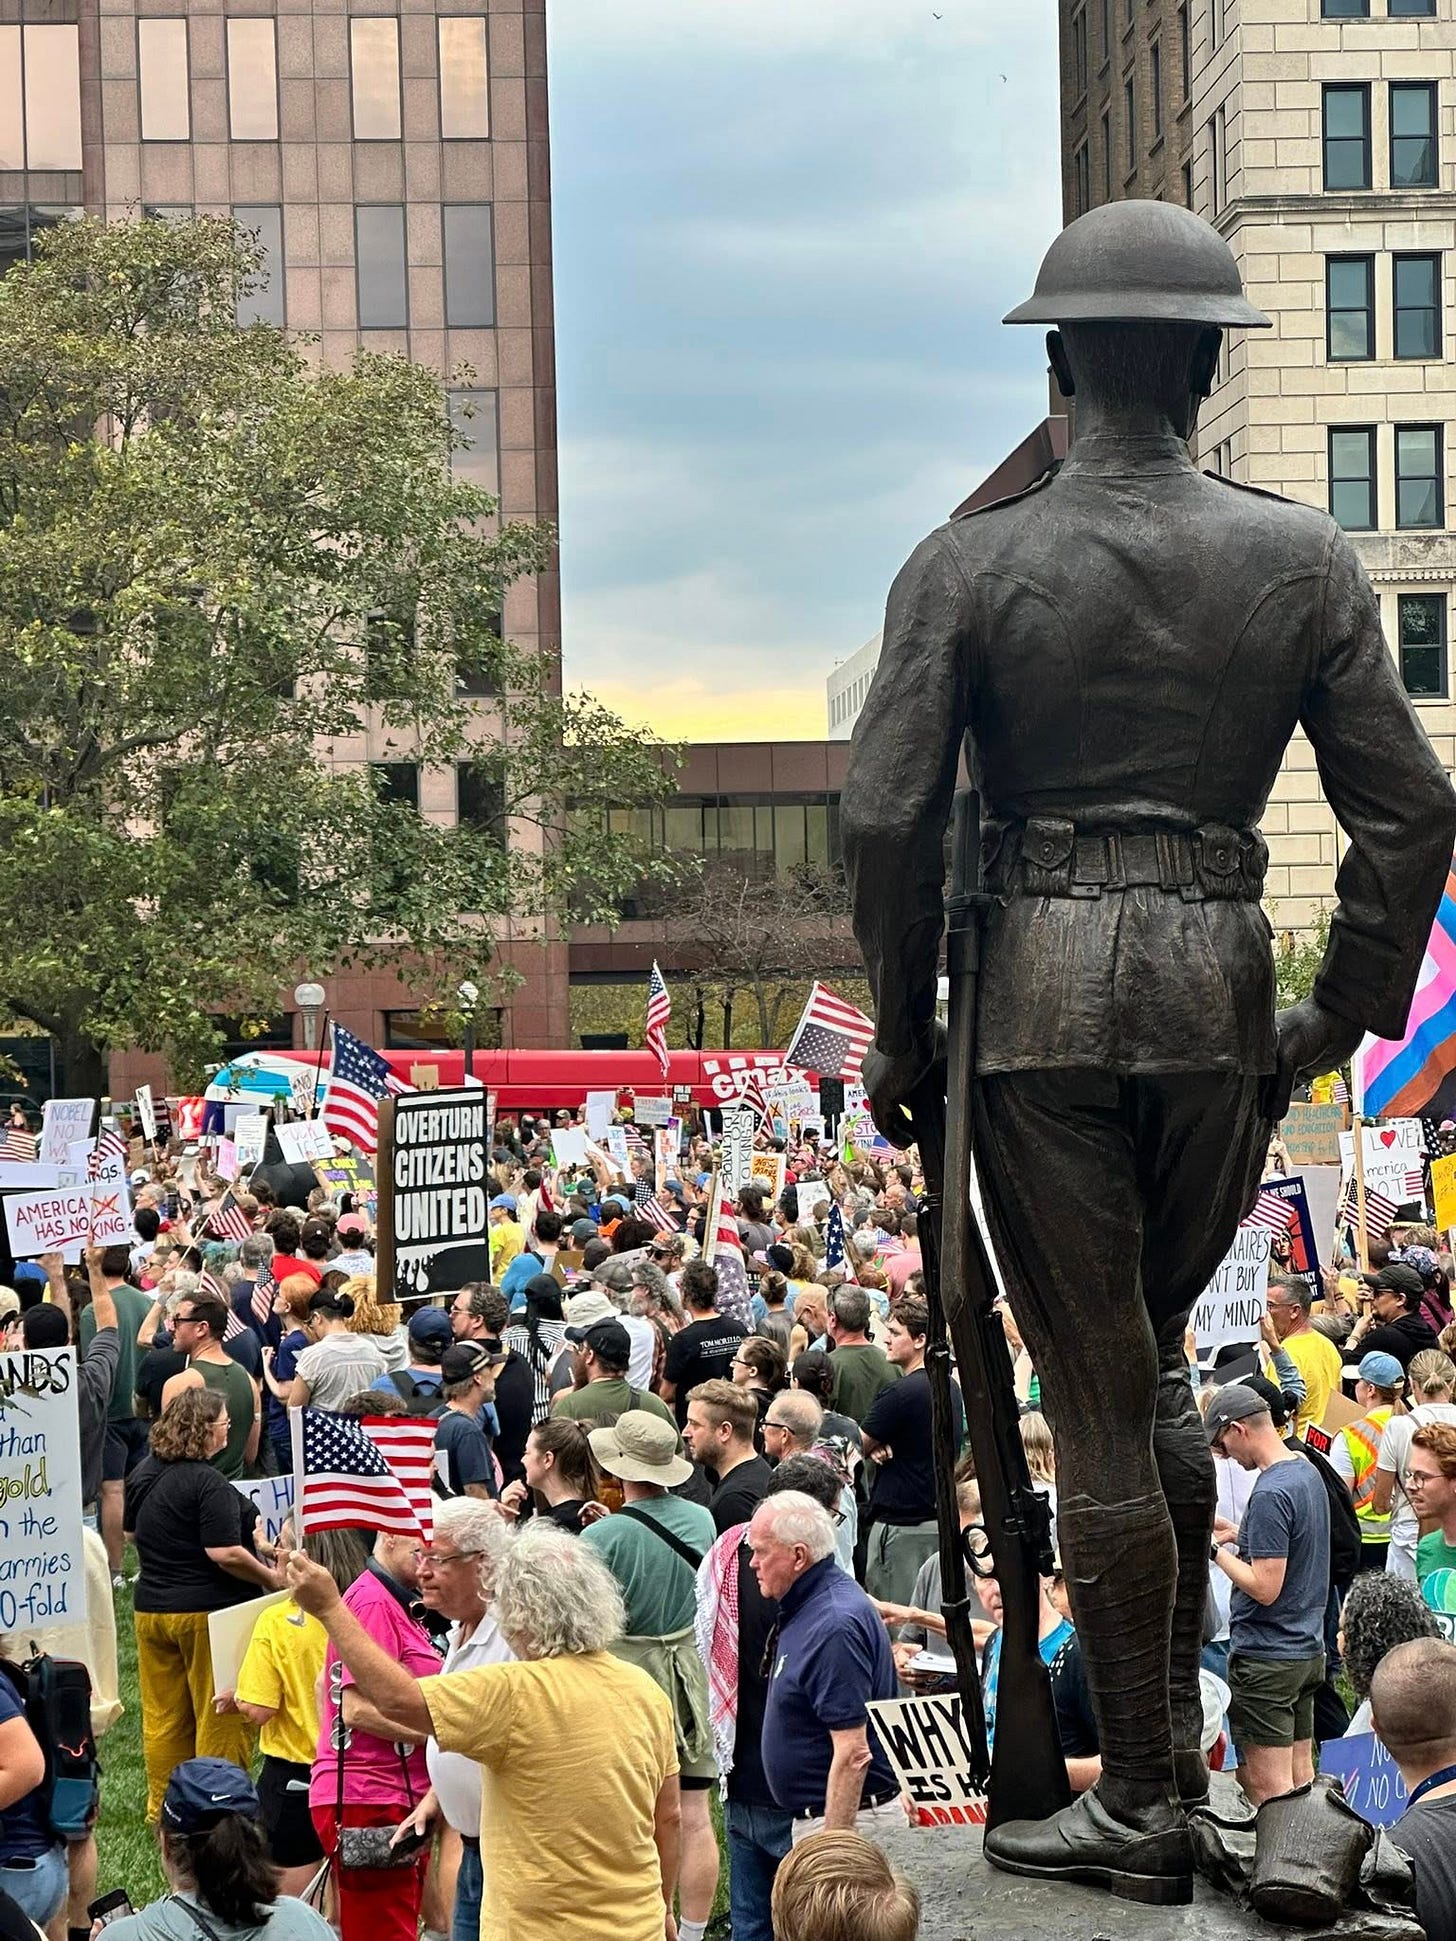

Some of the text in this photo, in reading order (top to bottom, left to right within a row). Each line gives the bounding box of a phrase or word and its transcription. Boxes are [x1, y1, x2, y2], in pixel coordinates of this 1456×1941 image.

[51, 1103, 88, 1121] NOBEL
[395, 1105, 484, 1145] OVERTURN
[730, 1113, 741, 1141] NO
[54, 1125, 74, 1139] NO
[740, 1114, 753, 1162] KINGS
[49, 1142, 68, 1158] WA
[296, 1136, 331, 1159] ICE
[394, 1142, 484, 1188] CITIZENS
[1363, 1161, 1408, 1178] merica
[16, 1196, 89, 1228] AMERICA
[394, 1186, 486, 1241] UNITED
[35, 1216, 125, 1241] HAS NO KING
[1207, 1266, 1260, 1294] N'T BUY
[1193, 1298, 1263, 1333] MY MIND
[0, 1353, 71, 1397] NDS
[0, 1427, 46, 1457] than
[1308, 1427, 1328, 1452] FOR
[0, 1456, 52, 1508] gold,
[18, 1507, 58, 1539] the
[0, 1552, 72, 1581] armies
[870, 1697, 971, 1771] WHY
[906, 1773, 952, 1803] IS
[1365, 1773, 1389, 1810] NO
